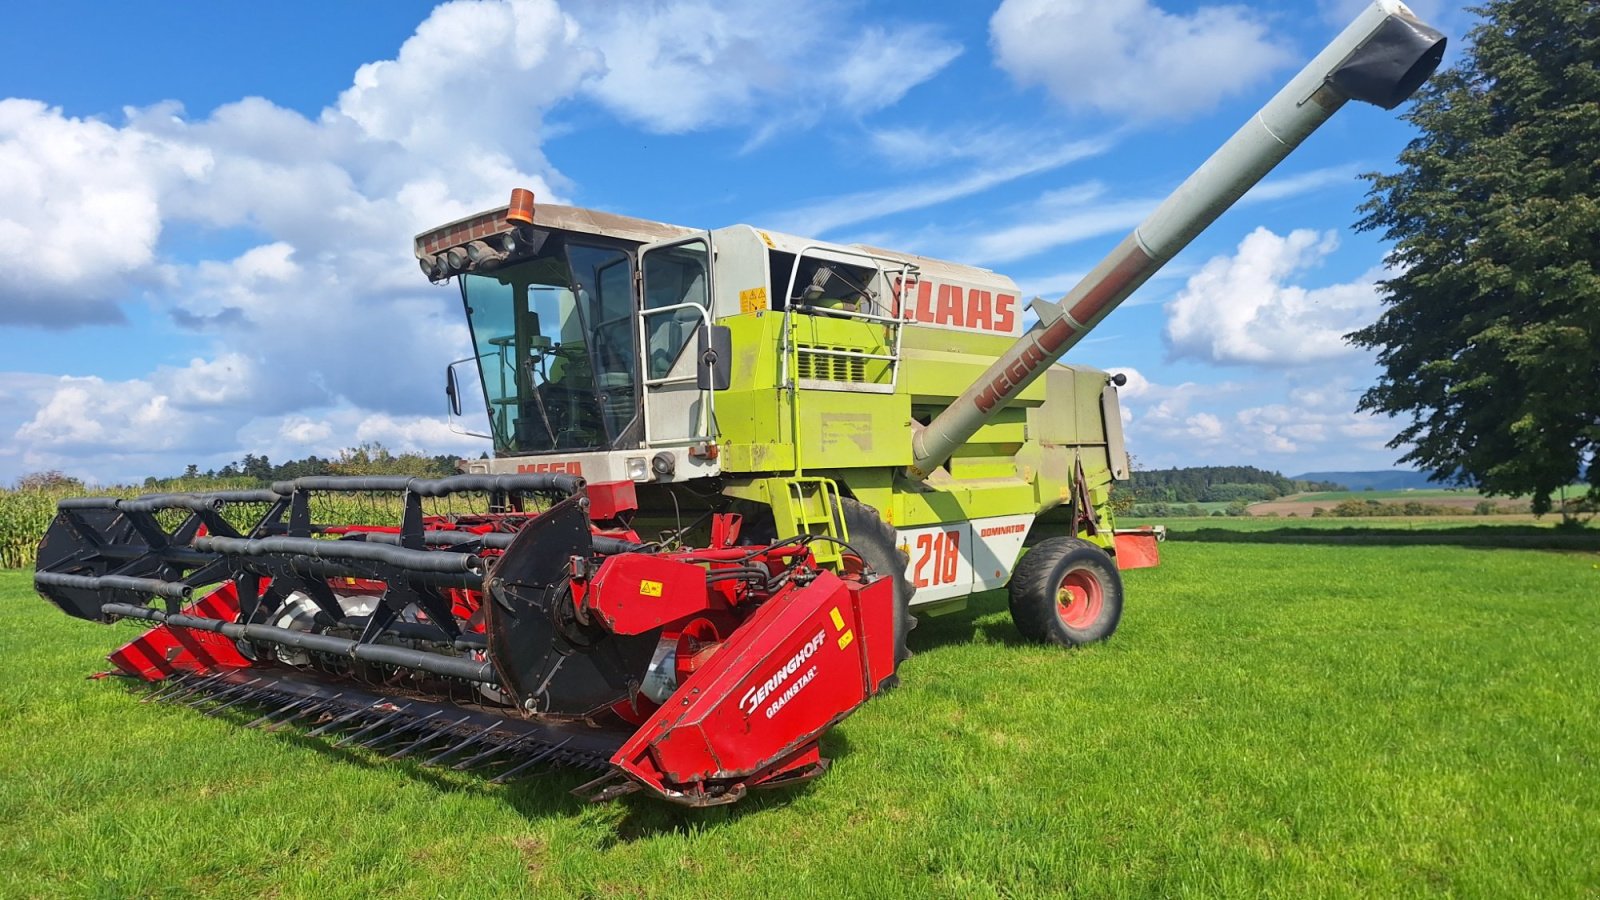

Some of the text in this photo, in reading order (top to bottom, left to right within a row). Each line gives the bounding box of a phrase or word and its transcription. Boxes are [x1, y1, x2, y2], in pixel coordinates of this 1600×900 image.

[891, 277, 1014, 333] CLAAS
[975, 344, 1046, 413] MEGA
[913, 531, 960, 588] 218
[981, 524, 1026, 538] DOMINATOR
[738, 629, 827, 715] GERINGHOFF
